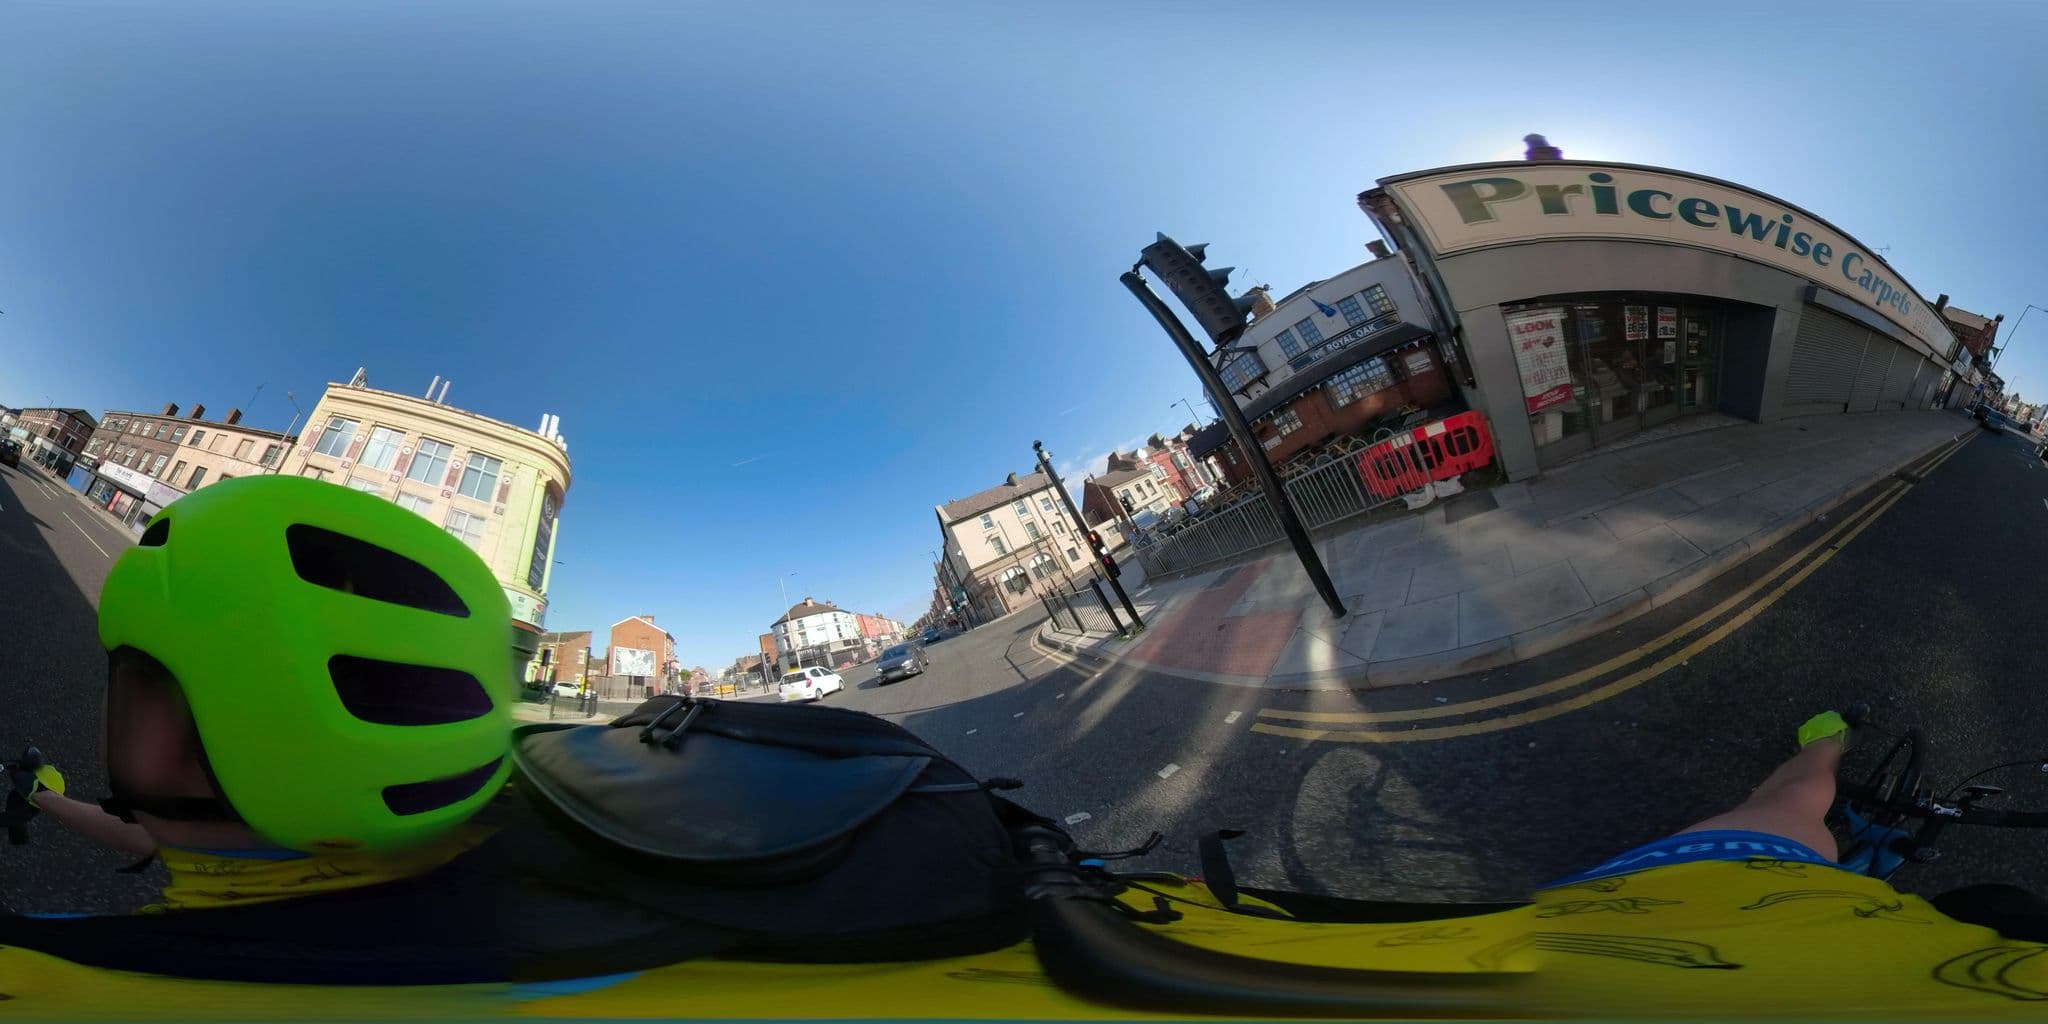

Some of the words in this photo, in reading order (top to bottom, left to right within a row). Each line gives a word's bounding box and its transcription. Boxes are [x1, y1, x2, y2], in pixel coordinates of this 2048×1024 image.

[1441, 173, 1833, 266] Pricewise
[1841, 252, 1912, 317] Carpets
[1326, 334, 1357, 351] ROYAL
[1356, 323, 1377, 337] OAK
[1514, 319, 1556, 335] LOOK
